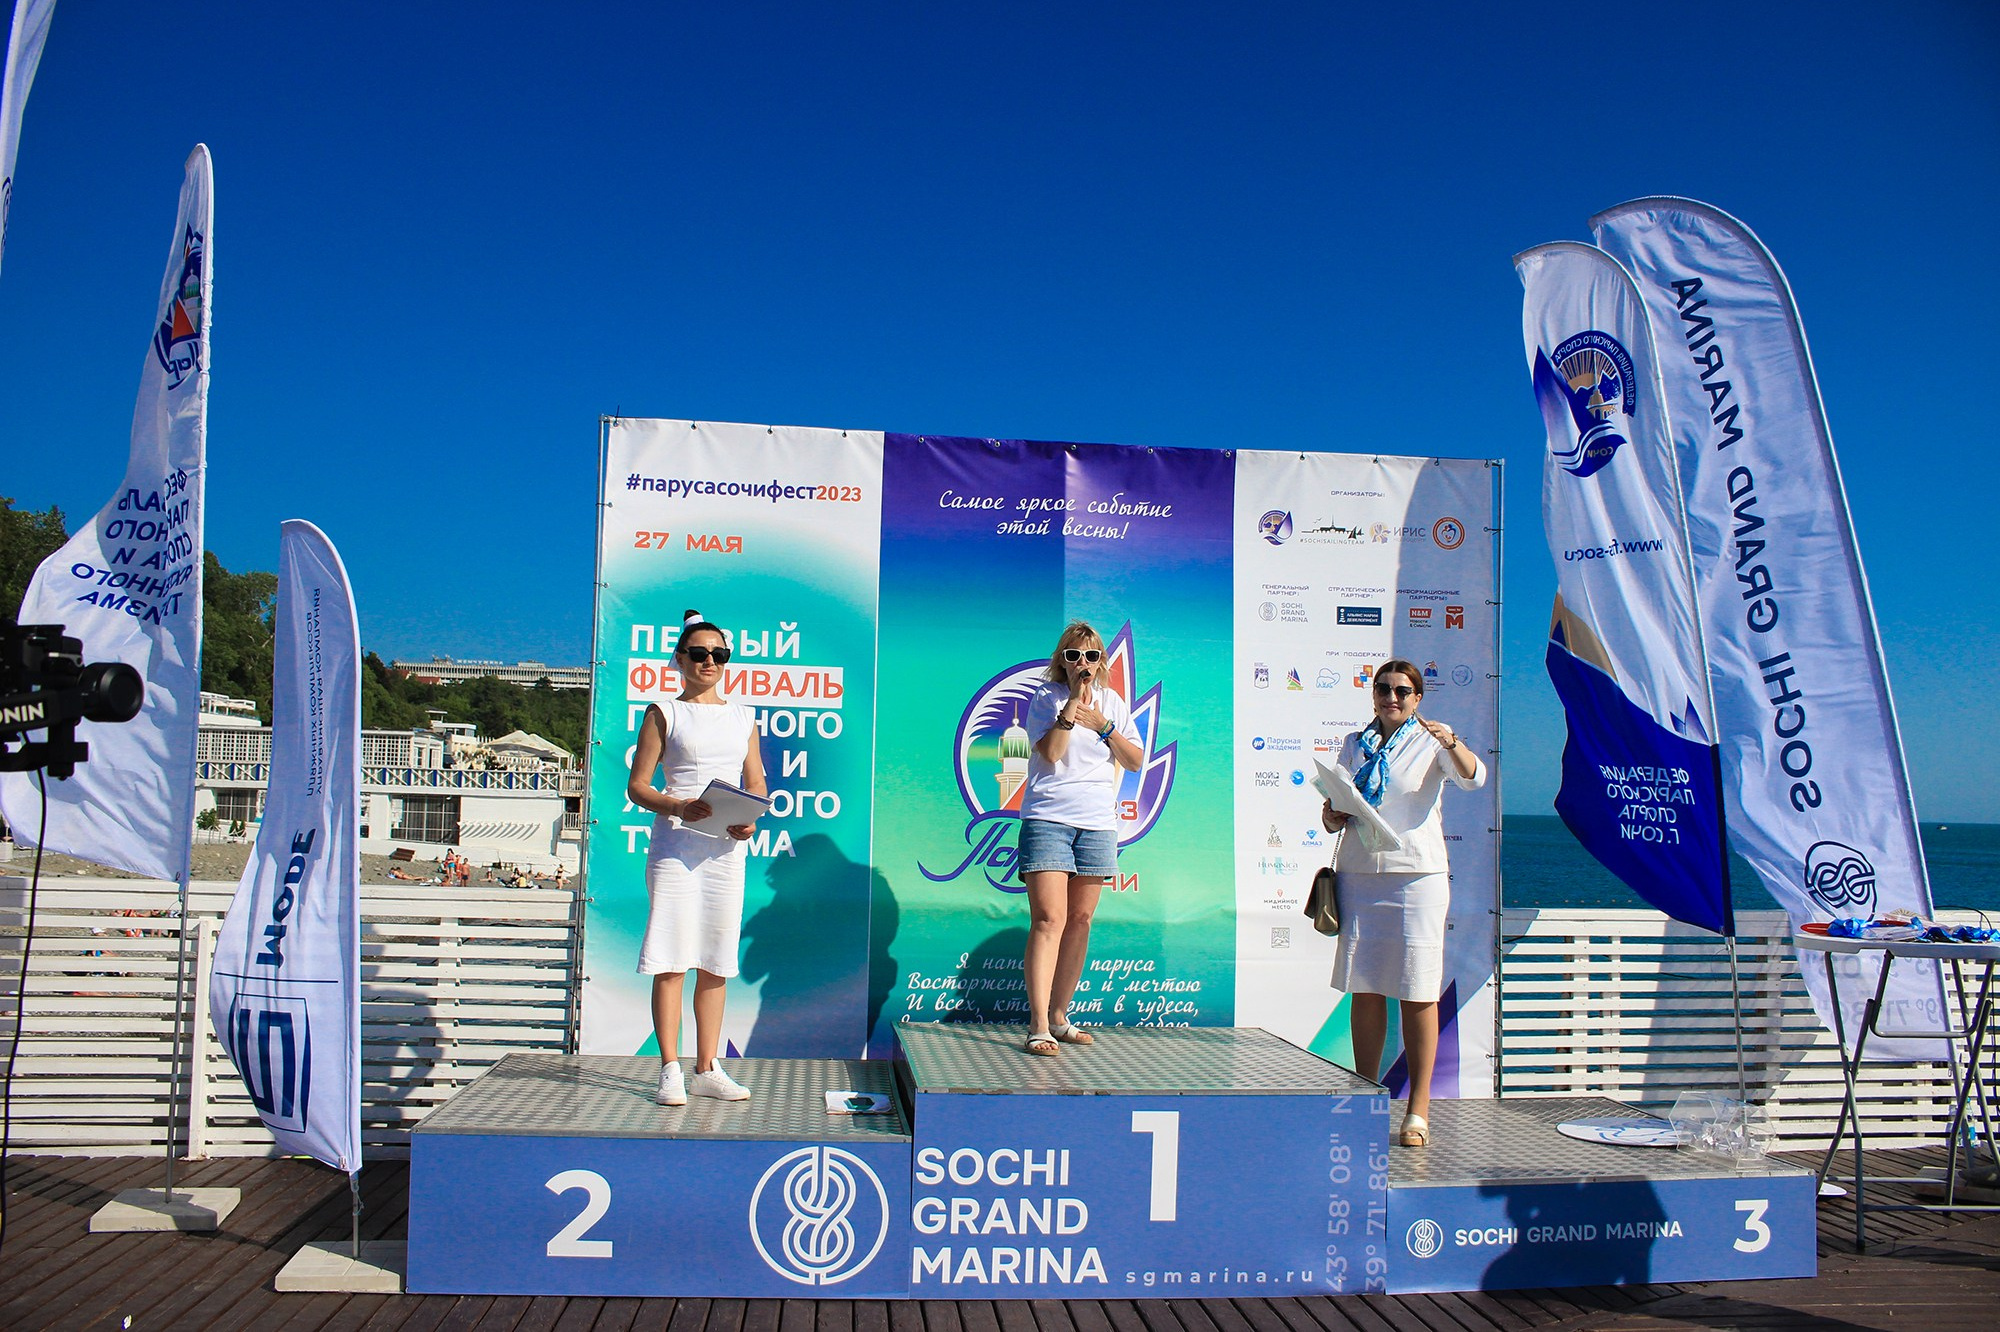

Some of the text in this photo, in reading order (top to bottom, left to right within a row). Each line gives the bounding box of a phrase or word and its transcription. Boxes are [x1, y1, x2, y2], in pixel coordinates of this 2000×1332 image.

[626, 474, 862, 503] #парусасочифест2023
[1330, 490, 1386, 498] ОРГАНИЗАТОРЫ:
[939, 489, 1174, 519] Самое яркое событие
[634, 531, 743, 553] 27 МАЯ
[996, 517, 1130, 540] этой весны!
[1393, 526, 1426, 537] ИРИС
[631, 621, 801, 659] ПЕВЫЙ
[1267, 737, 1301, 745] Парусная
[782, 750, 807, 778] И
[1255, 771, 1273, 779] МОЙ
[1255, 779, 1280, 787] ПАРУС
[955, 952, 1156, 980] Я напо паруса
[1101, 979, 1114, 992] и
[1124, 977, 1202, 992] мечтою
[905, 993, 924, 1011] И
[934, 992, 980, 1015] всех,
[1113, 994, 1126, 1014] в
[1136, 995, 1199, 1022] чудеса,
[915, 1147, 1070, 1186] SOCHI
[1131, 1110, 1180, 1222] 1
[544, 1169, 613, 1258] 2
[913, 1197, 1088, 1235] GRAND
[1732, 1199, 1771, 1253] 3
[1454, 1221, 1683, 1246] SOCHI GRAND MARINA
[912, 1246, 1109, 1284] MARINA
[1126, 1267, 1313, 1287] sgmarina.ru
